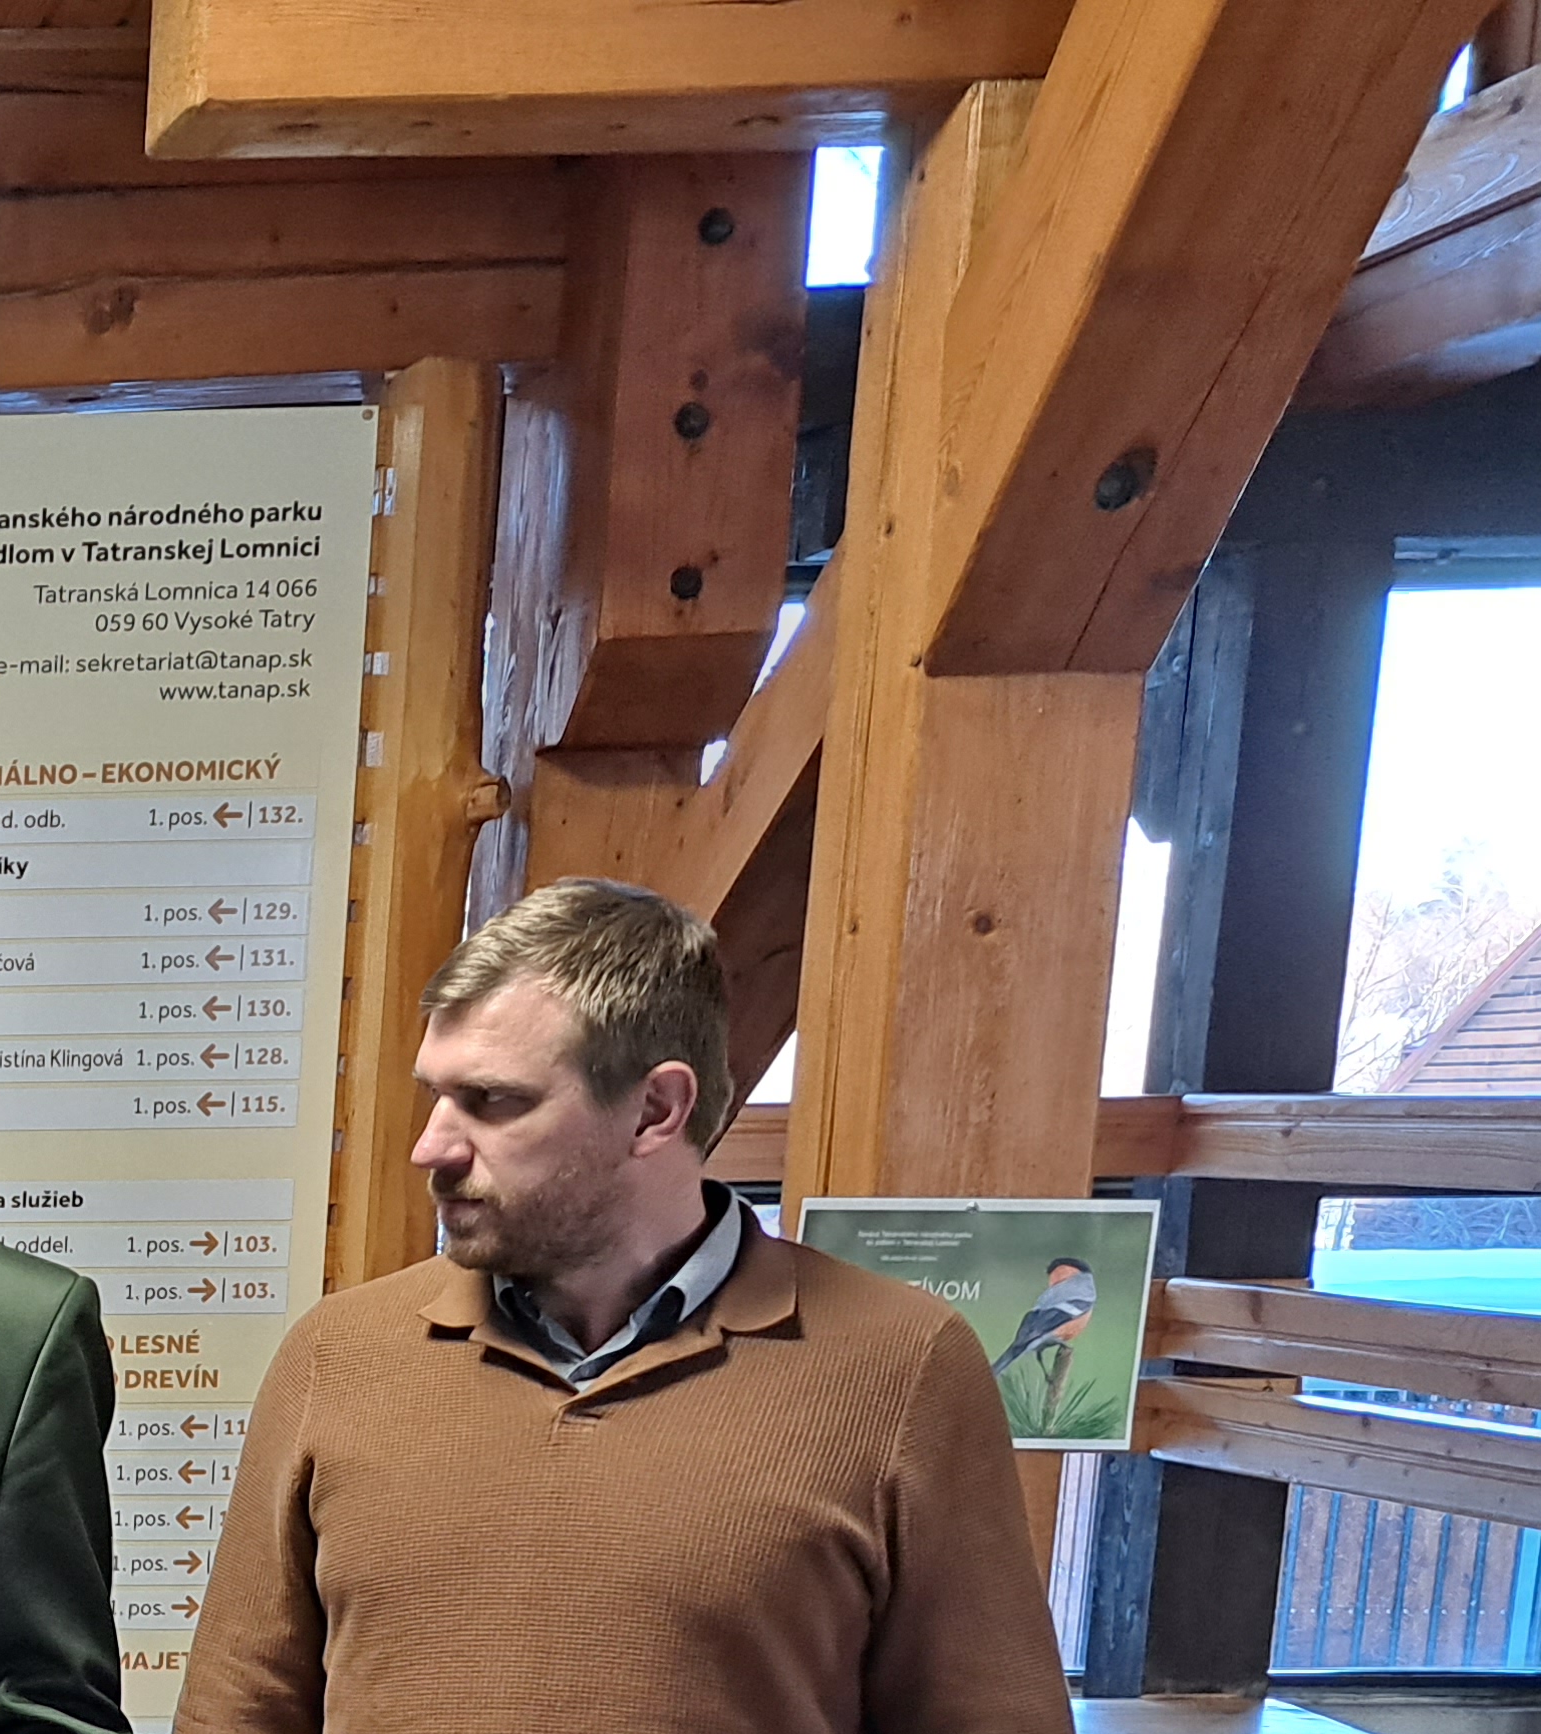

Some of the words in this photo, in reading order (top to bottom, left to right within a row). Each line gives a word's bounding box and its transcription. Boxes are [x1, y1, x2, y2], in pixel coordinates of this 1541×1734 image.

[108, 504, 245, 528] národného
[250, 501, 322, 527] parku
[62, 548, 75, 563] v
[81, 539, 212, 564] Tatranskej
[219, 537, 320, 560] Lomnici
[33, 582, 138, 604] Tatranská
[145, 581, 237, 601] Lomnica
[245, 581, 270, 599] 14
[276, 578, 318, 598] 066
[95, 613, 136, 633] 059
[141, 612, 168, 632] 60
[174, 610, 253, 635] Vysoké
[259, 609, 315, 632] Tatry
[75, 650, 312, 675] sekretariat@tanap.sk
[159, 680, 310, 702] www.tanap.sk
[101, 752, 281, 784] EKONOMICKÝ
[24, 809, 65, 829] odb.
[148, 809, 164, 827] 1.
[168, 810, 208, 831] pos.
[258, 805, 303, 825] 132.
[144, 905, 159, 922] 1.
[163, 905, 202, 925] pos.
[253, 903, 297, 922] 129.
[141, 952, 157, 969] 1.
[161, 953, 199, 973] pos.
[250, 949, 294, 968] 131.
[139, 1003, 153, 1020] 1.
[158, 1003, 197, 1023] pos.
[247, 999, 291, 1018] 130.
[50, 1049, 122, 1071] Klingová
[137, 1050, 151, 1067] 1.
[155, 1050, 195, 1071] pos.
[245, 1047, 289, 1066] 128.
[134, 1098, 149, 1114] 1.
[153, 1098, 191, 1118] pos.
[241, 1095, 285, 1114] 115.
[12, 1190, 83, 1208] služieb
[15, 1236, 73, 1253] oddel.
[127, 1237, 142, 1253] 1.
[147, 1238, 184, 1257] pos.
[233, 1236, 277, 1253] 103.
[121, 1330, 200, 1354] LESNÉ
[125, 1364, 218, 1389] DREVÍN
